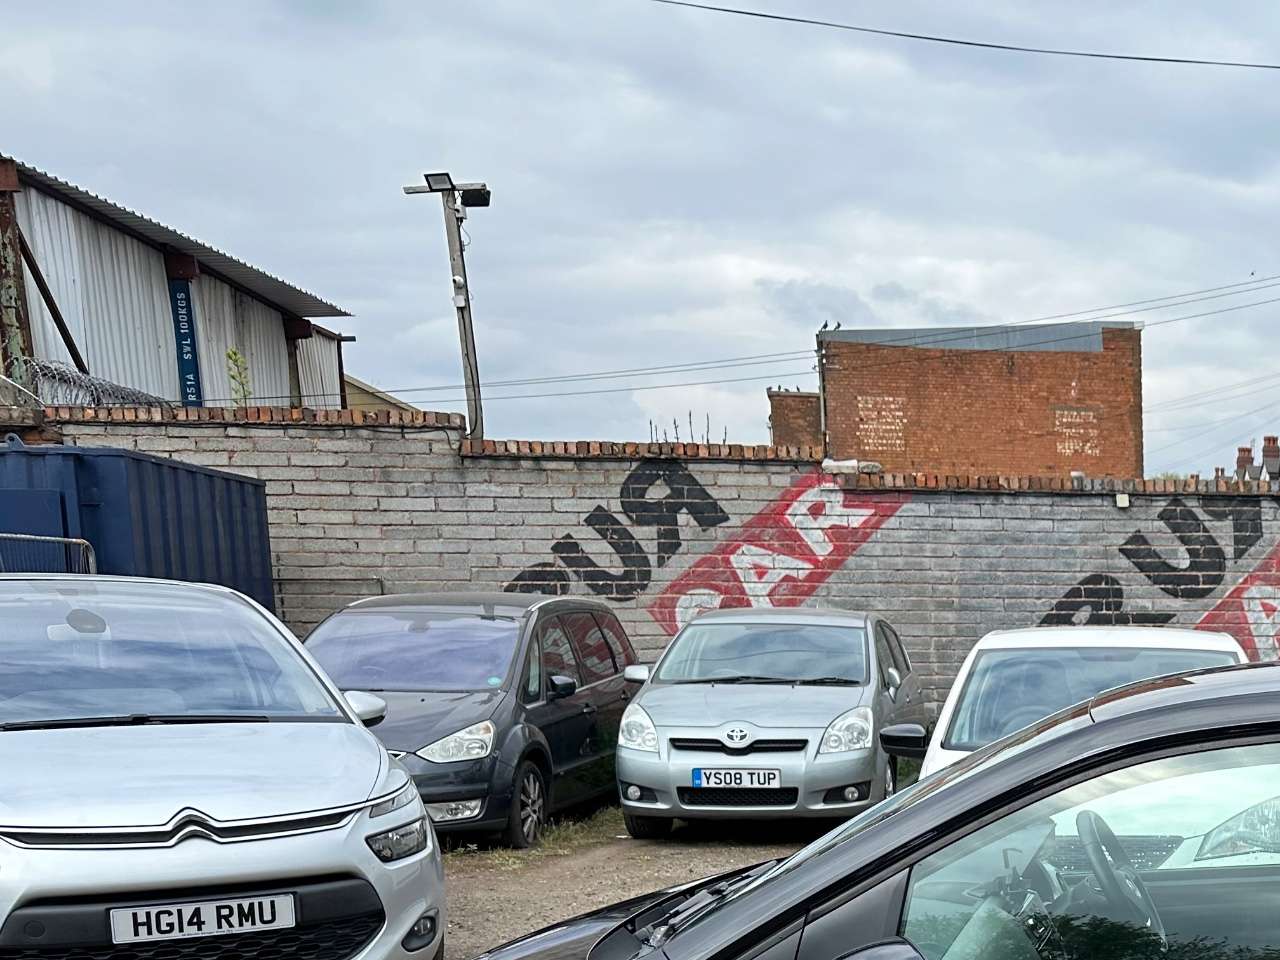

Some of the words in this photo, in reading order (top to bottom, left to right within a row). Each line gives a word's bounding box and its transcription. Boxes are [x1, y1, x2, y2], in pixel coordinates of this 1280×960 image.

[177, 292, 189, 334] 100KGS
[182, 338, 192, 360] SWL
[703, 771, 743, 785] YS08
[747, 772, 776, 785] TUP
[132, 906, 206, 937] HG14
[216, 899, 277, 930] RMU
